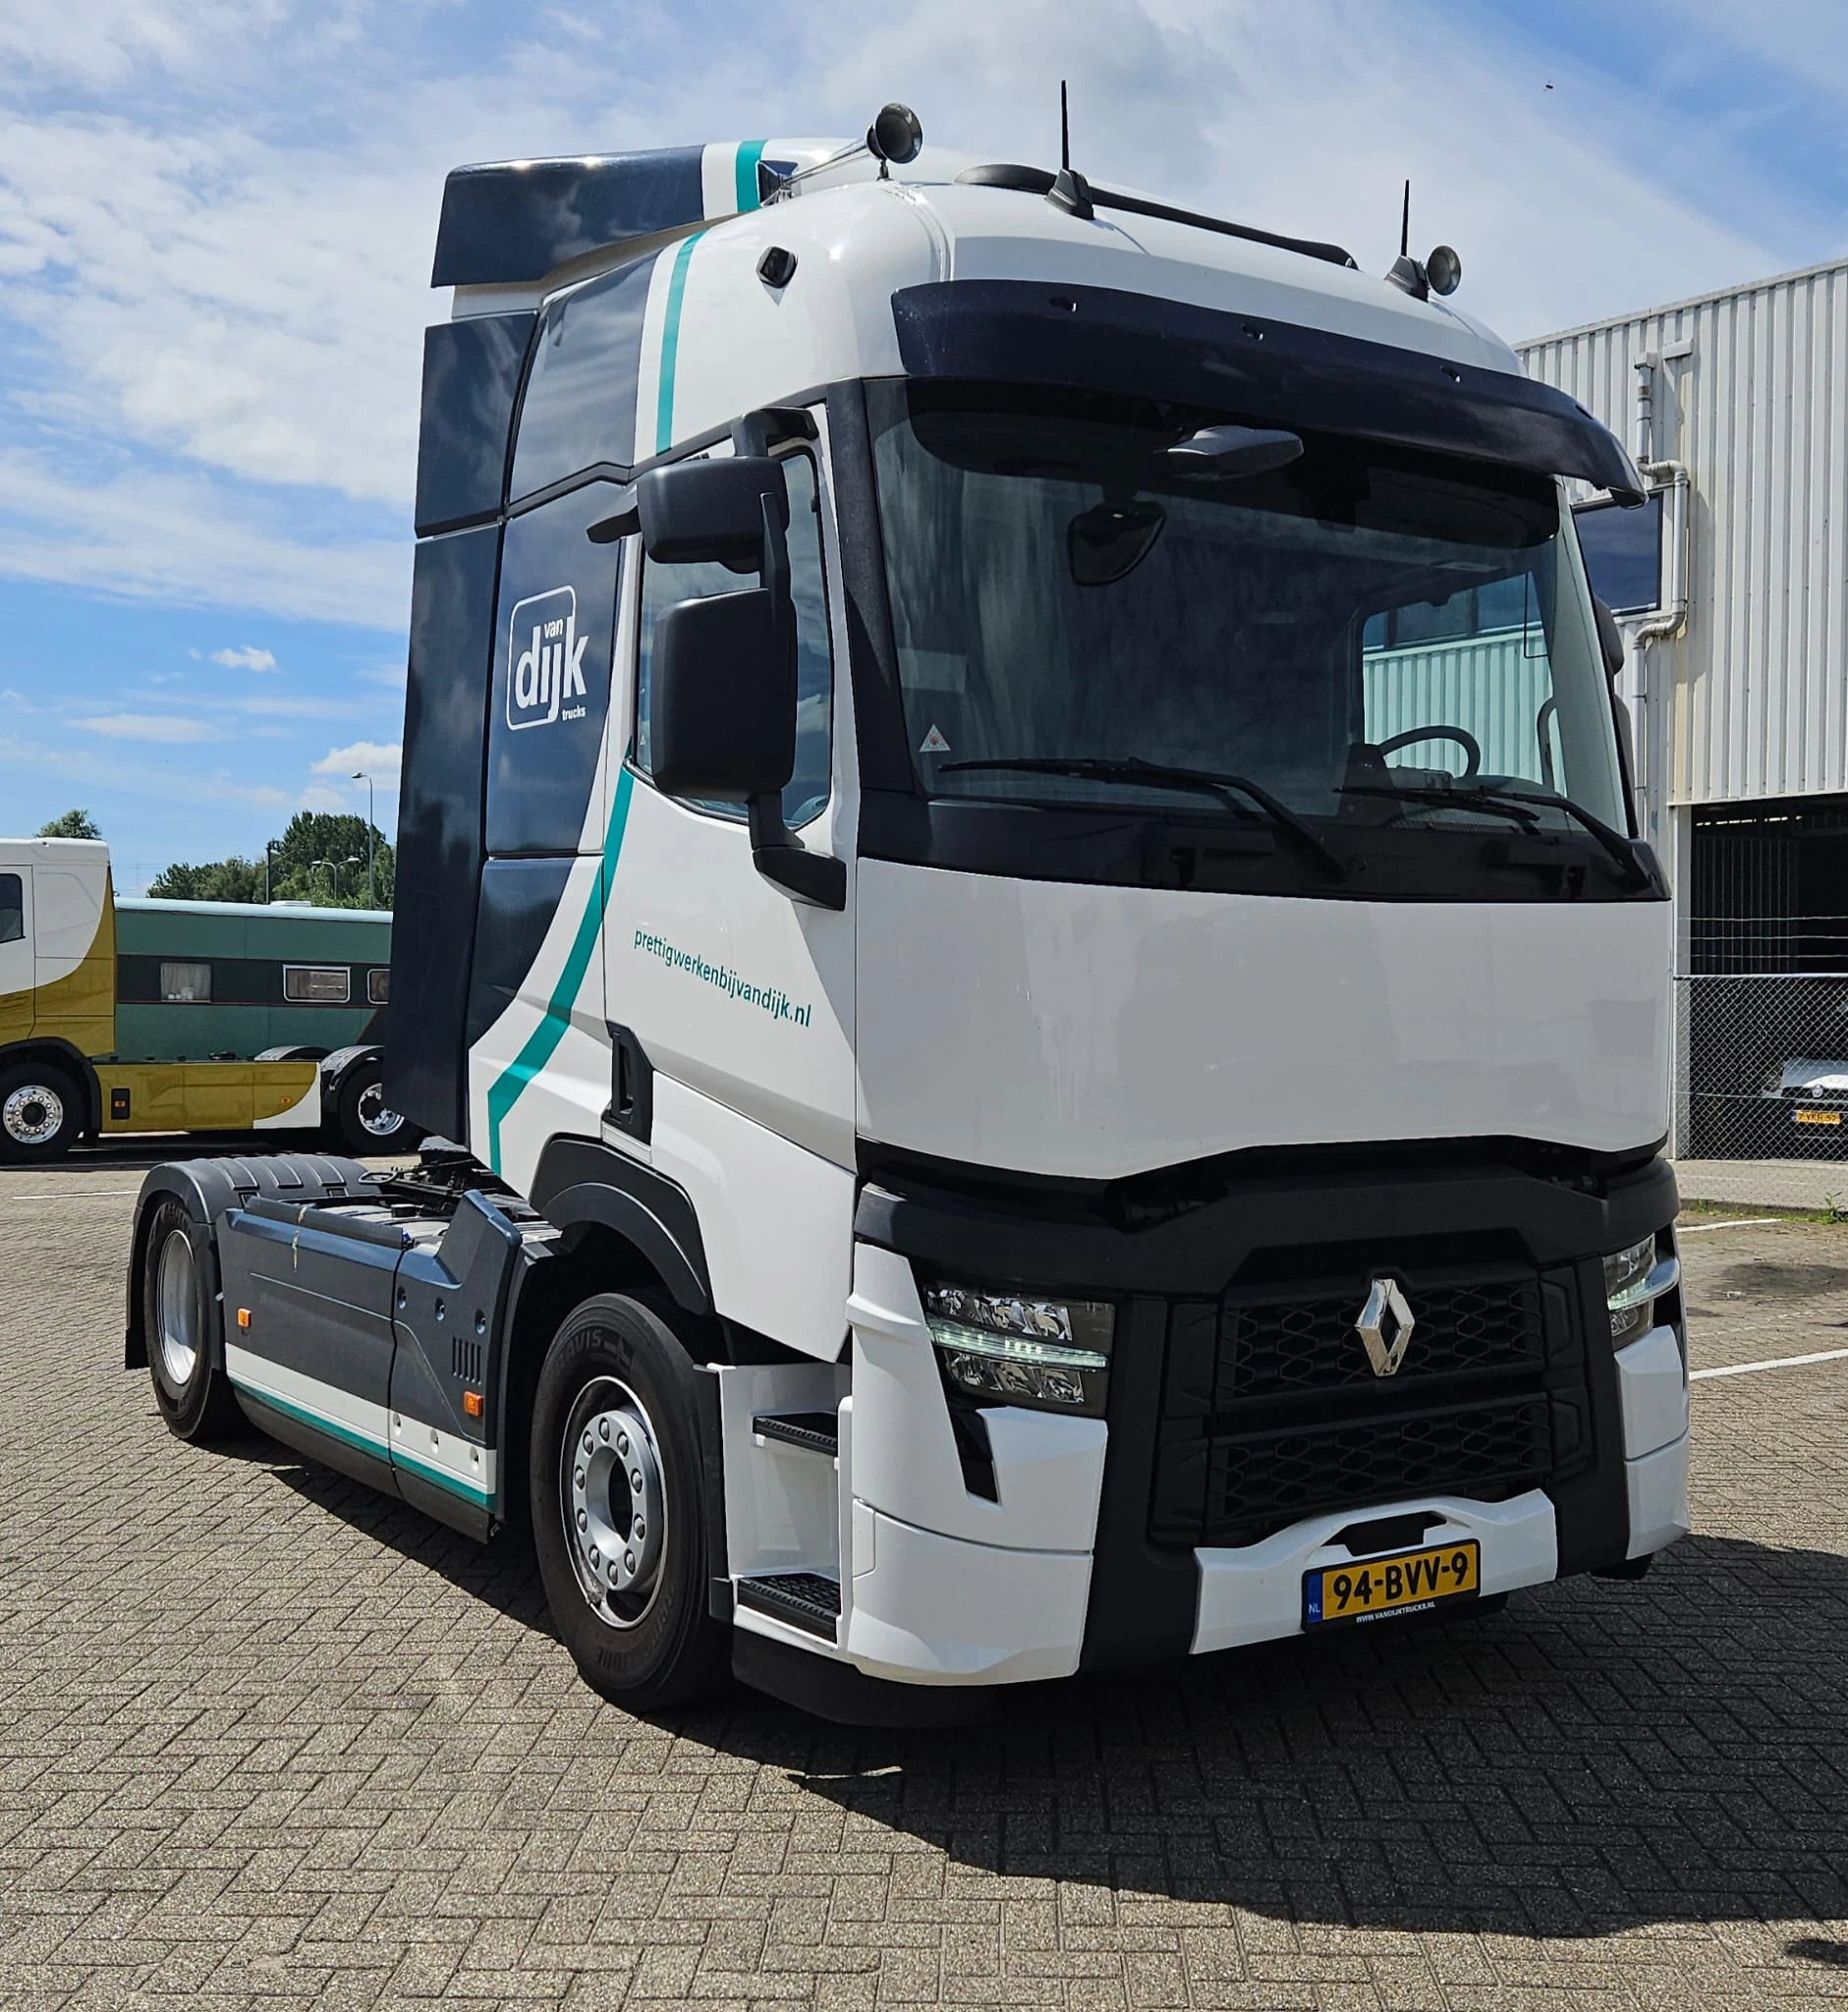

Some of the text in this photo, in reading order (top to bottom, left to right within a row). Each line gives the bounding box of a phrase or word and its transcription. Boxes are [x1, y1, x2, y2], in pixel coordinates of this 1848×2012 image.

[543, 618, 564, 639] van
[515, 615, 589, 723] dijk
[561, 704, 587, 721] trucks
[634, 928, 812, 1028] prettigwerkenbijvandijk.nl
[1332, 1551, 1469, 1610] 94-BVV-9
[1308, 1602, 1321, 1614] NL
